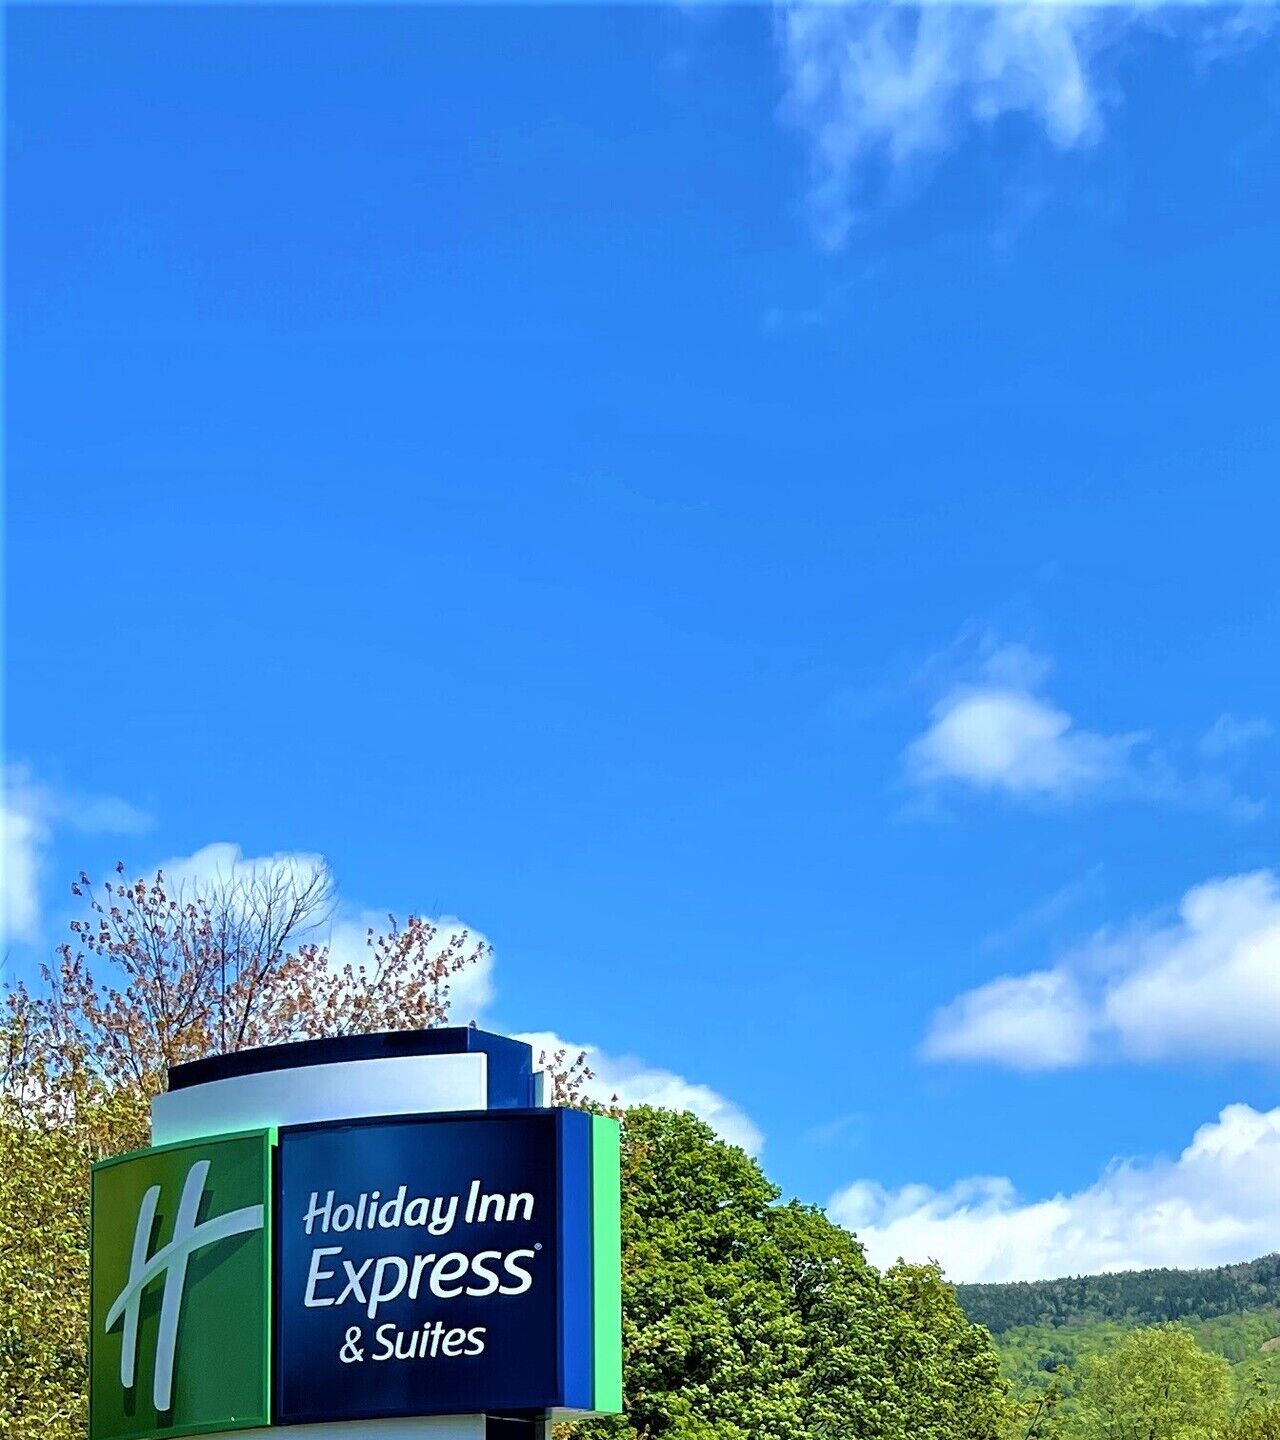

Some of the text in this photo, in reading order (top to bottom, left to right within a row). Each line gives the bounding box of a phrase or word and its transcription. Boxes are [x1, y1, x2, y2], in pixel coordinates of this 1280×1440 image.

[302, 1180, 535, 1236] Holiday Inn
[304, 1245, 536, 1320] Express
[338, 1321, 487, 1364] & Suites
